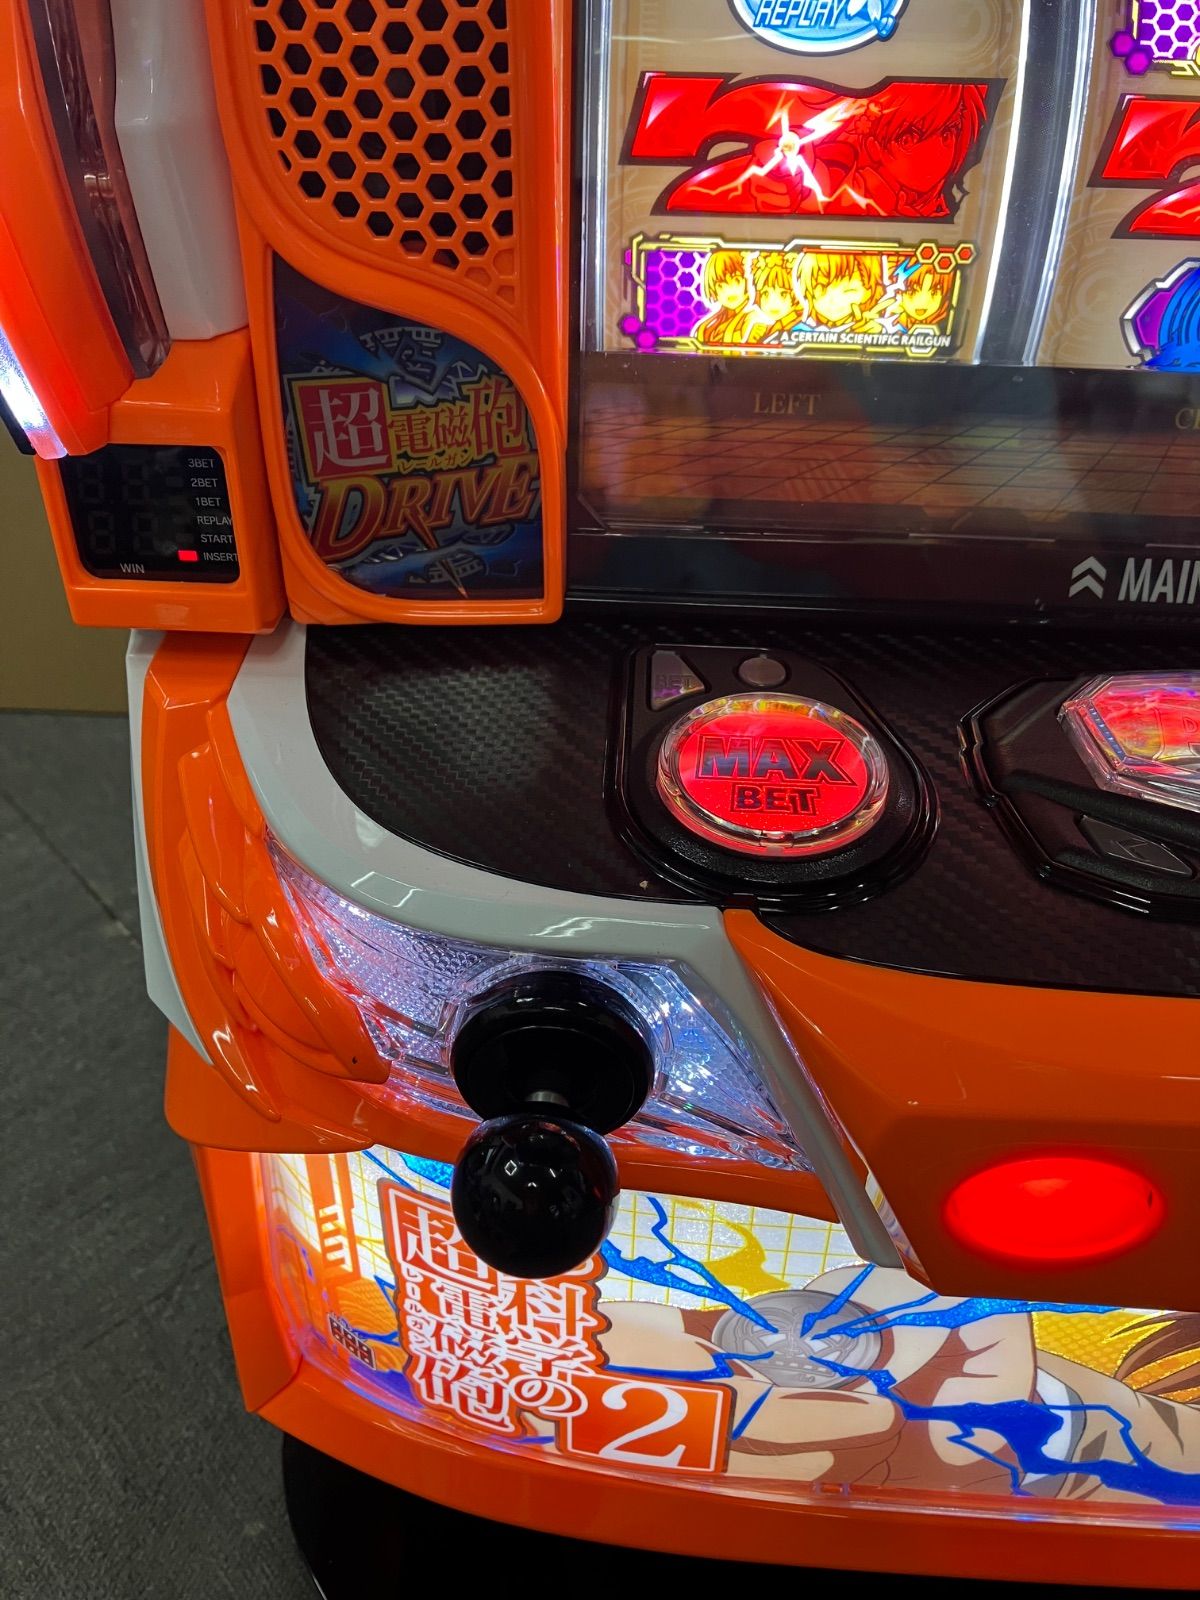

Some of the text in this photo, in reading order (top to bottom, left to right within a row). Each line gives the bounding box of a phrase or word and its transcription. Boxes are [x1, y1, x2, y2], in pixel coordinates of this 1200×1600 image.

[754, 0, 845, 28] REPLAY
[780, 332, 952, 348] A CERTAIN SCIENTIFIC RAILGUN
[752, 391, 822, 416] LEFT
[308, 378, 530, 473] 超電磁砲
[188, 458, 215, 469] 3BET
[190, 478, 218, 488] 2BET
[195, 497, 221, 507] 1BET
[311, 456, 538, 561] DRIVE
[196, 515, 232, 526] REPLAY
[200, 534, 233, 544] START
[203, 551, 238, 562] INSERT
[119, 562, 145, 574] WIN
[697, 735, 854, 786] MAX
[731, 784, 820, 815] BET
[600, 1382, 689, 1468] 2
